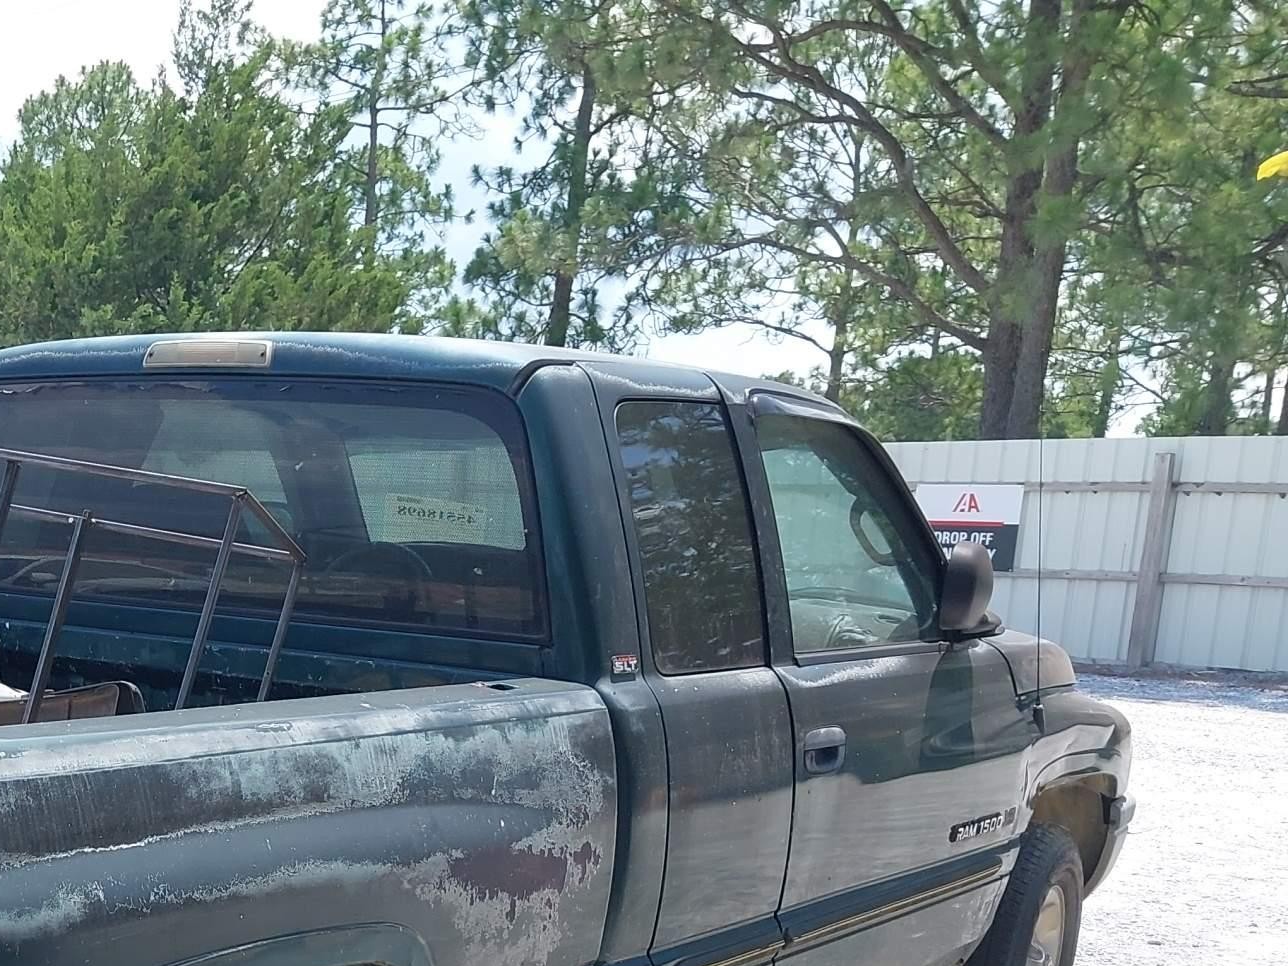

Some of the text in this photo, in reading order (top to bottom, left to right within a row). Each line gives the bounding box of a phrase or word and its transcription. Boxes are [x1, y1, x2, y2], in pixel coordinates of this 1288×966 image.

[934, 531, 994, 546] DROP OFF
[614, 659, 638, 671] SLT
[956, 822, 978, 841] RAM
[978, 815, 1003, 836] 1500
